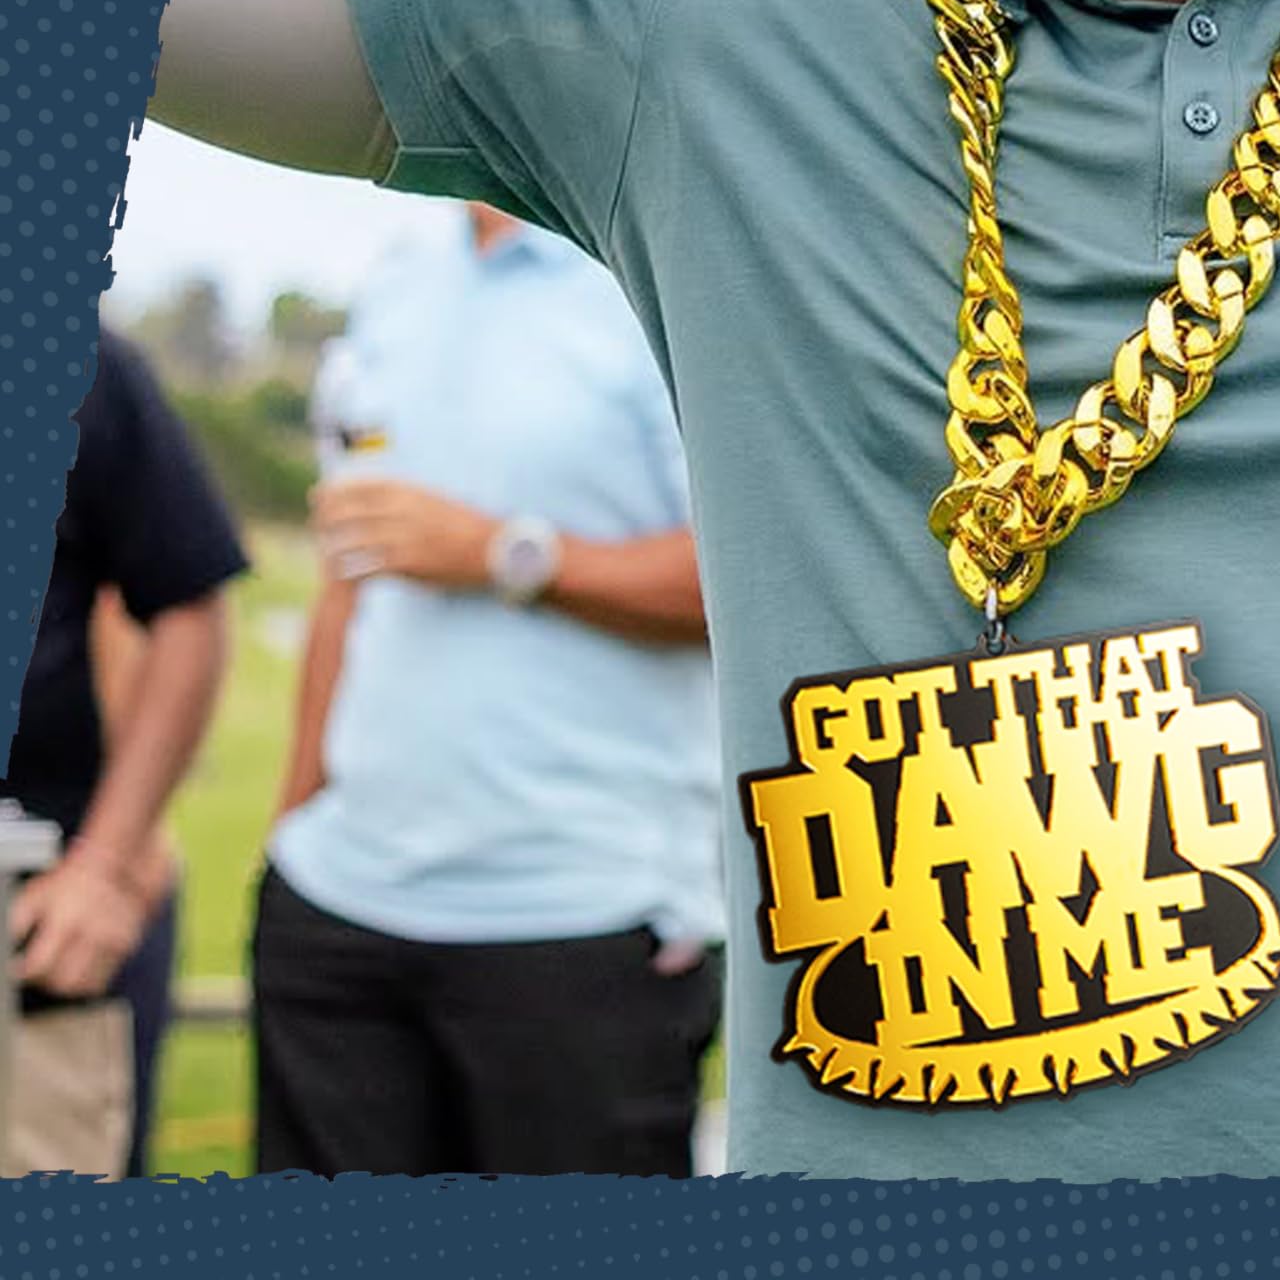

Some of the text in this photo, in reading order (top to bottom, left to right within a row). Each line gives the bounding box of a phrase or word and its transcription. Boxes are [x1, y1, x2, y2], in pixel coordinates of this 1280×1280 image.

[792, 626, 1200, 767] GOT THAT
[751, 697, 1278, 953] DAWG
[864, 871, 1214, 1047] IN ME
